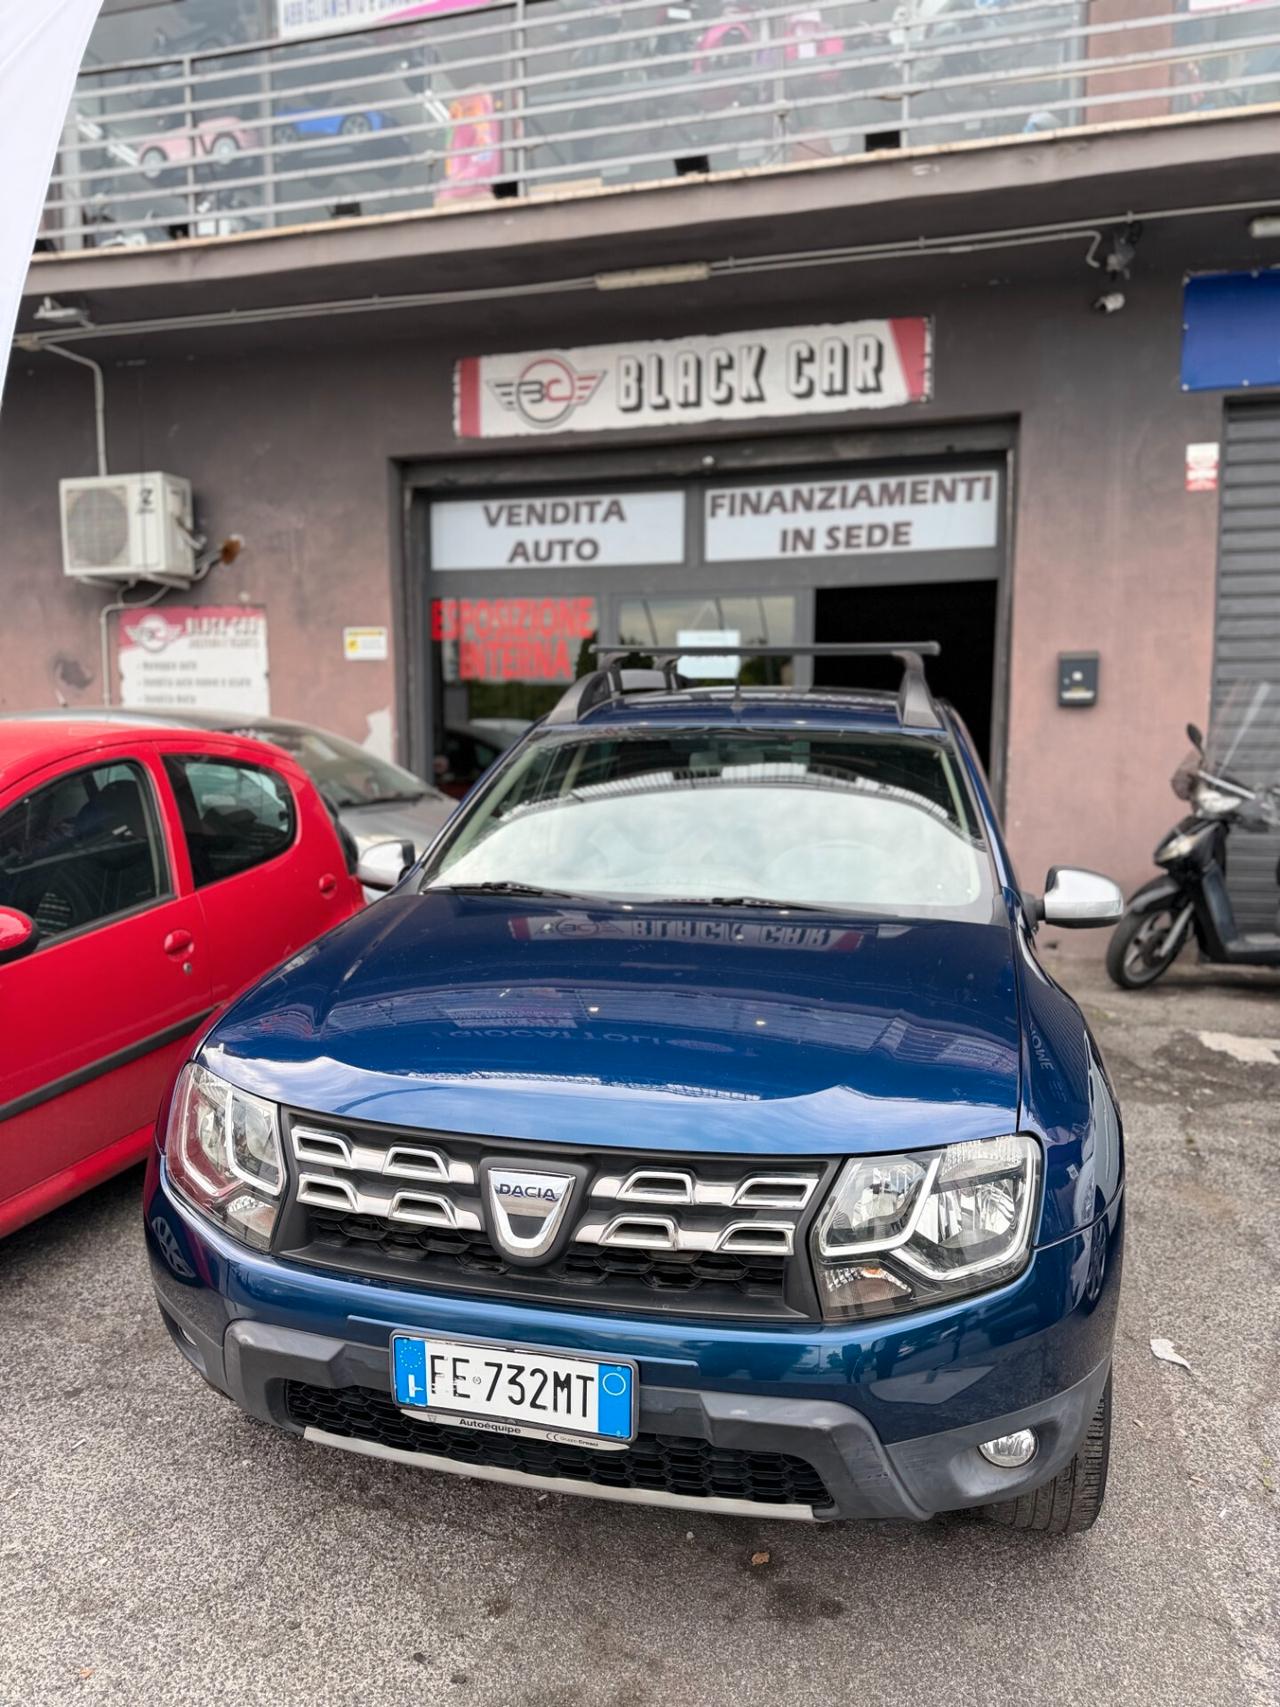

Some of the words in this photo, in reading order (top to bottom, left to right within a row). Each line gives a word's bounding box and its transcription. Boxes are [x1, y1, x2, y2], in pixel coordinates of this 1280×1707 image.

[618, 345, 766, 412] BLACK
[788, 334, 883, 397] CAR
[483, 500, 626, 527] VENDITA
[709, 476, 992, 517] FINANZIAMENTI
[509, 538, 600, 563] AUTO
[780, 528, 815, 553] IN
[825, 522, 912, 550] SEDE
[431, 598, 595, 641] ESPOSIZIONE
[460, 640, 572, 680] INTERNA
[499, 1183, 556, 1201] DACIA
[484, 1361, 595, 1418] 732MT
